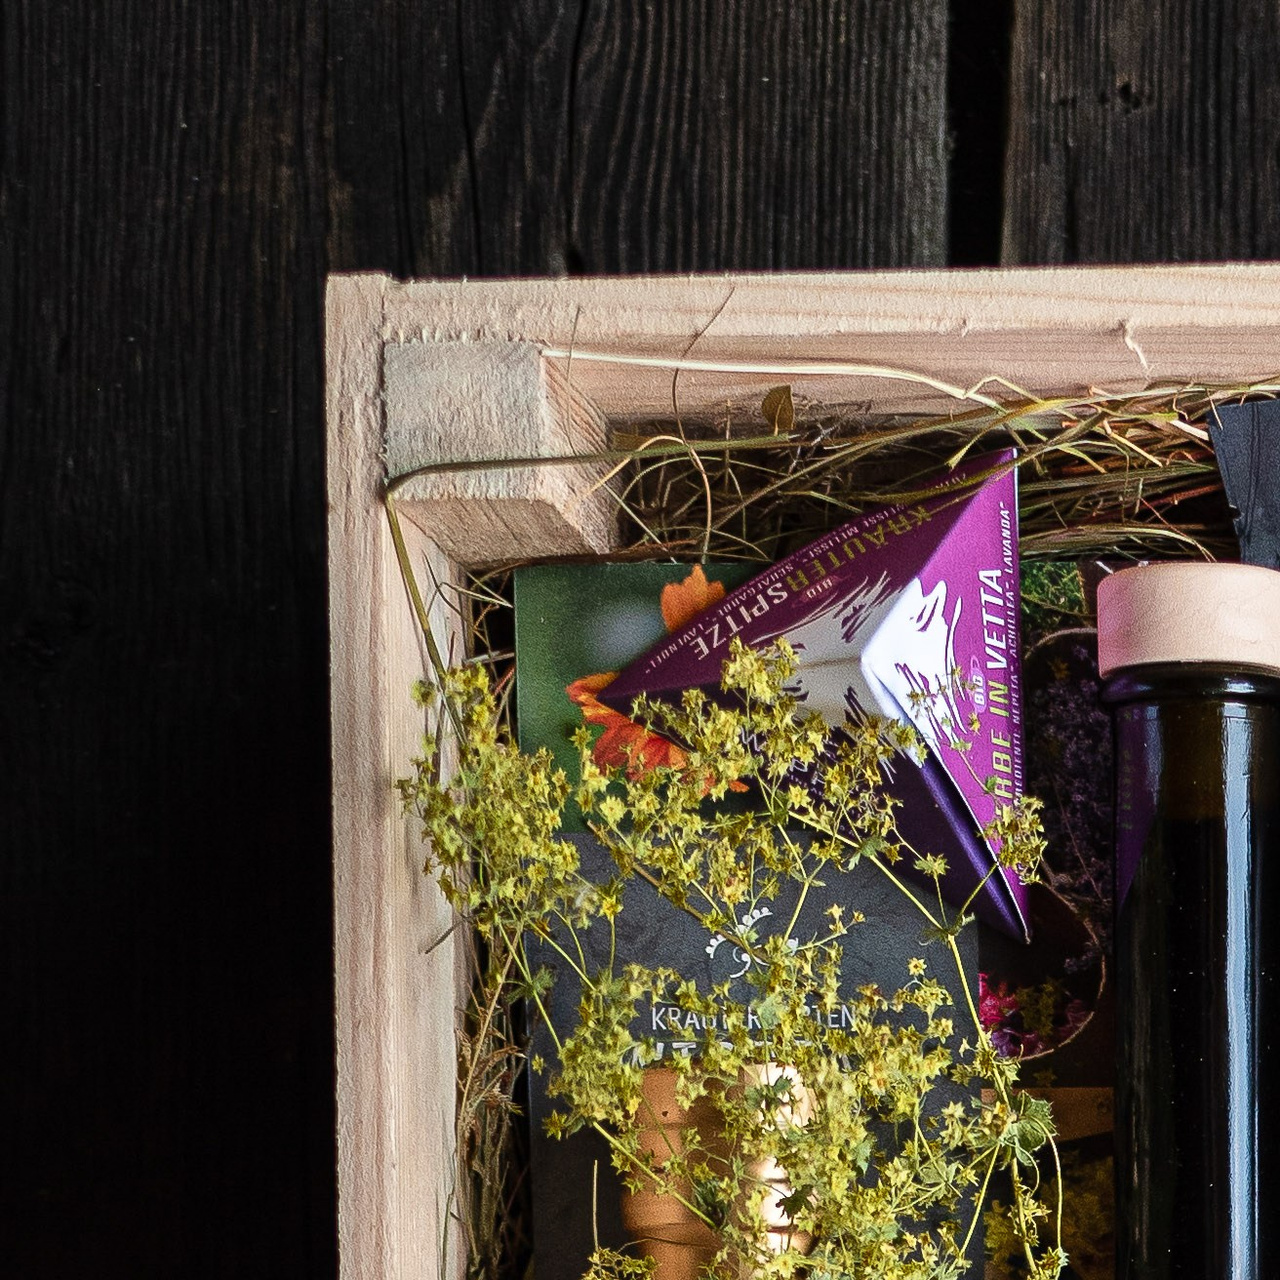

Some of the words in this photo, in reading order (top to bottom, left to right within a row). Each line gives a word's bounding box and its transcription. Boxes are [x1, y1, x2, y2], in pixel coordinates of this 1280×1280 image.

[689, 503, 933, 660] KRÄUTERSPITZE
[979, 570, 1007, 668] VETTA
[989, 681, 1009, 717] IN
